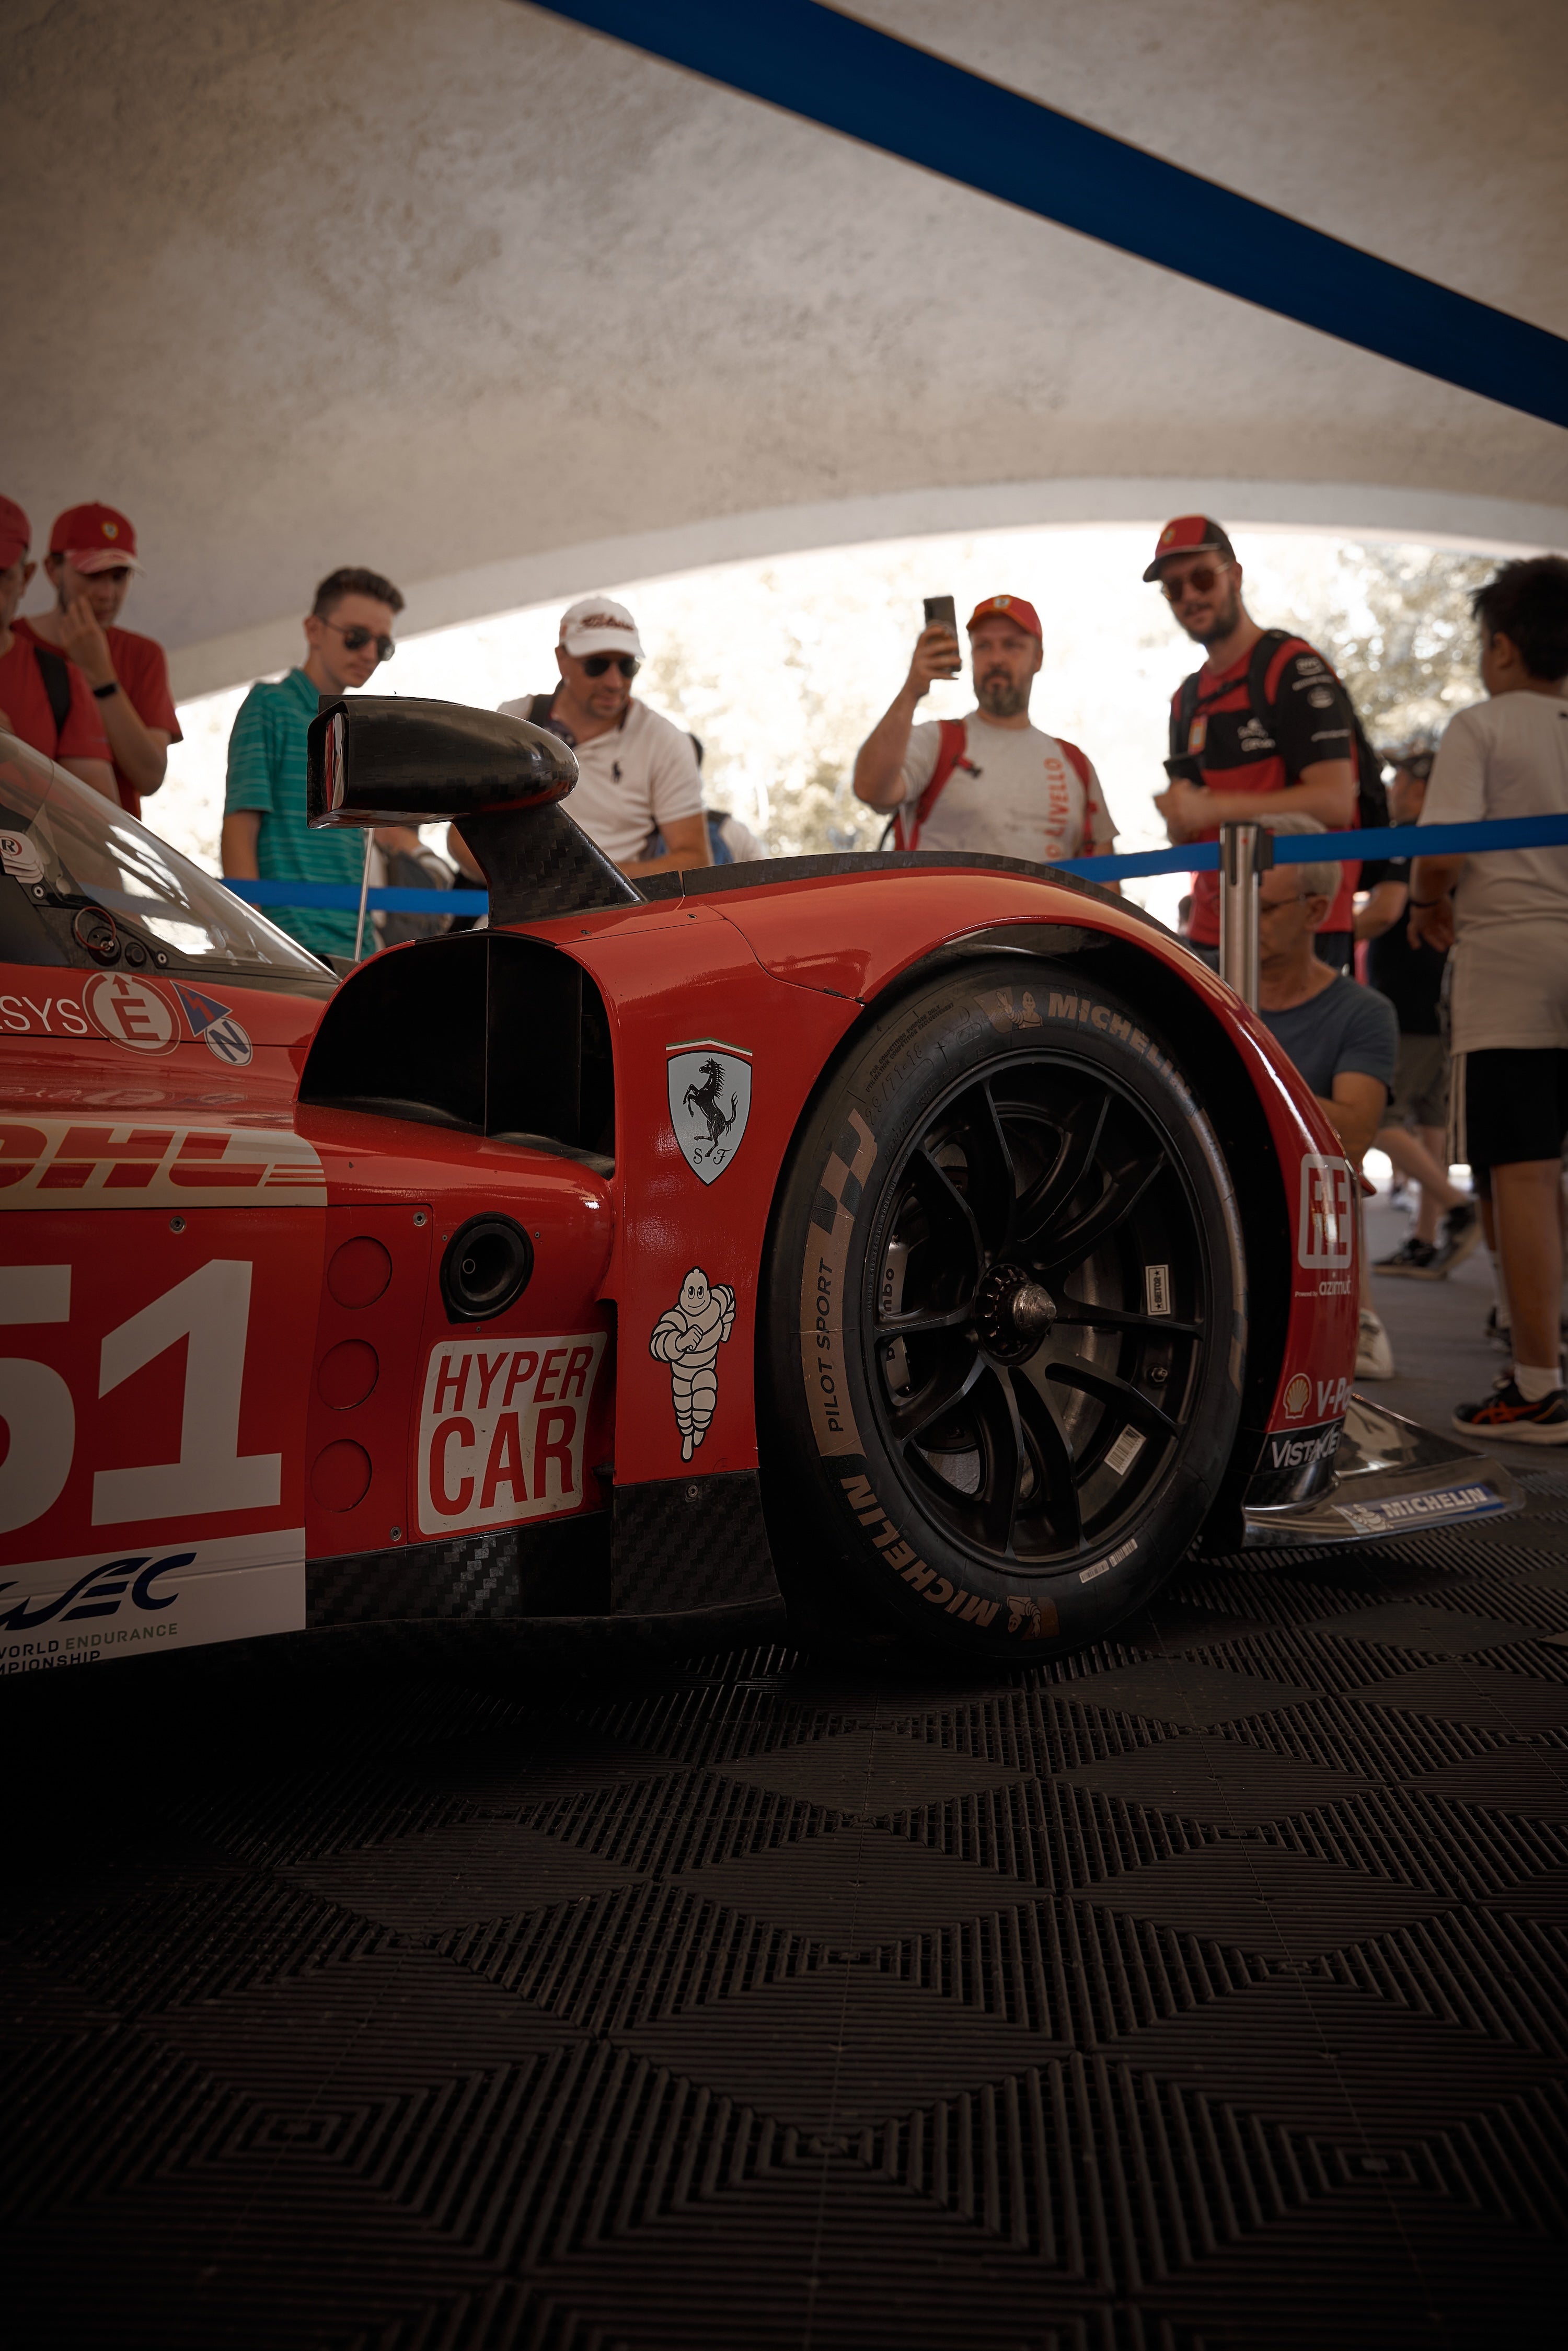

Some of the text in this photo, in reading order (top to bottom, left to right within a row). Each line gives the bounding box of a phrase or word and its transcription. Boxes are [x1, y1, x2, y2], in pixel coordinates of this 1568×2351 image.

[1044, 758, 1069, 837] LIVELLO
[0, 995, 88, 1034] SYS
[870, 1065, 879, 1077] FOR
[879, 1034, 906, 1063] COMPETITION
[889, 1030, 918, 1059] COMPETITION
[1048, 993, 1192, 1097] MICHELIN
[1319, 1271, 1351, 1296] azimut
[816, 1257, 843, 1432] PILOT SPORT
[433, 1346, 594, 1414] HYPER
[430, 1405, 576, 1515] CAR
[1380, 1487, 1489, 1518] MICHELIN
[840, 1474, 1001, 1627] MICHELIN
[66, 1622, 178, 1650] ENDURANCE
